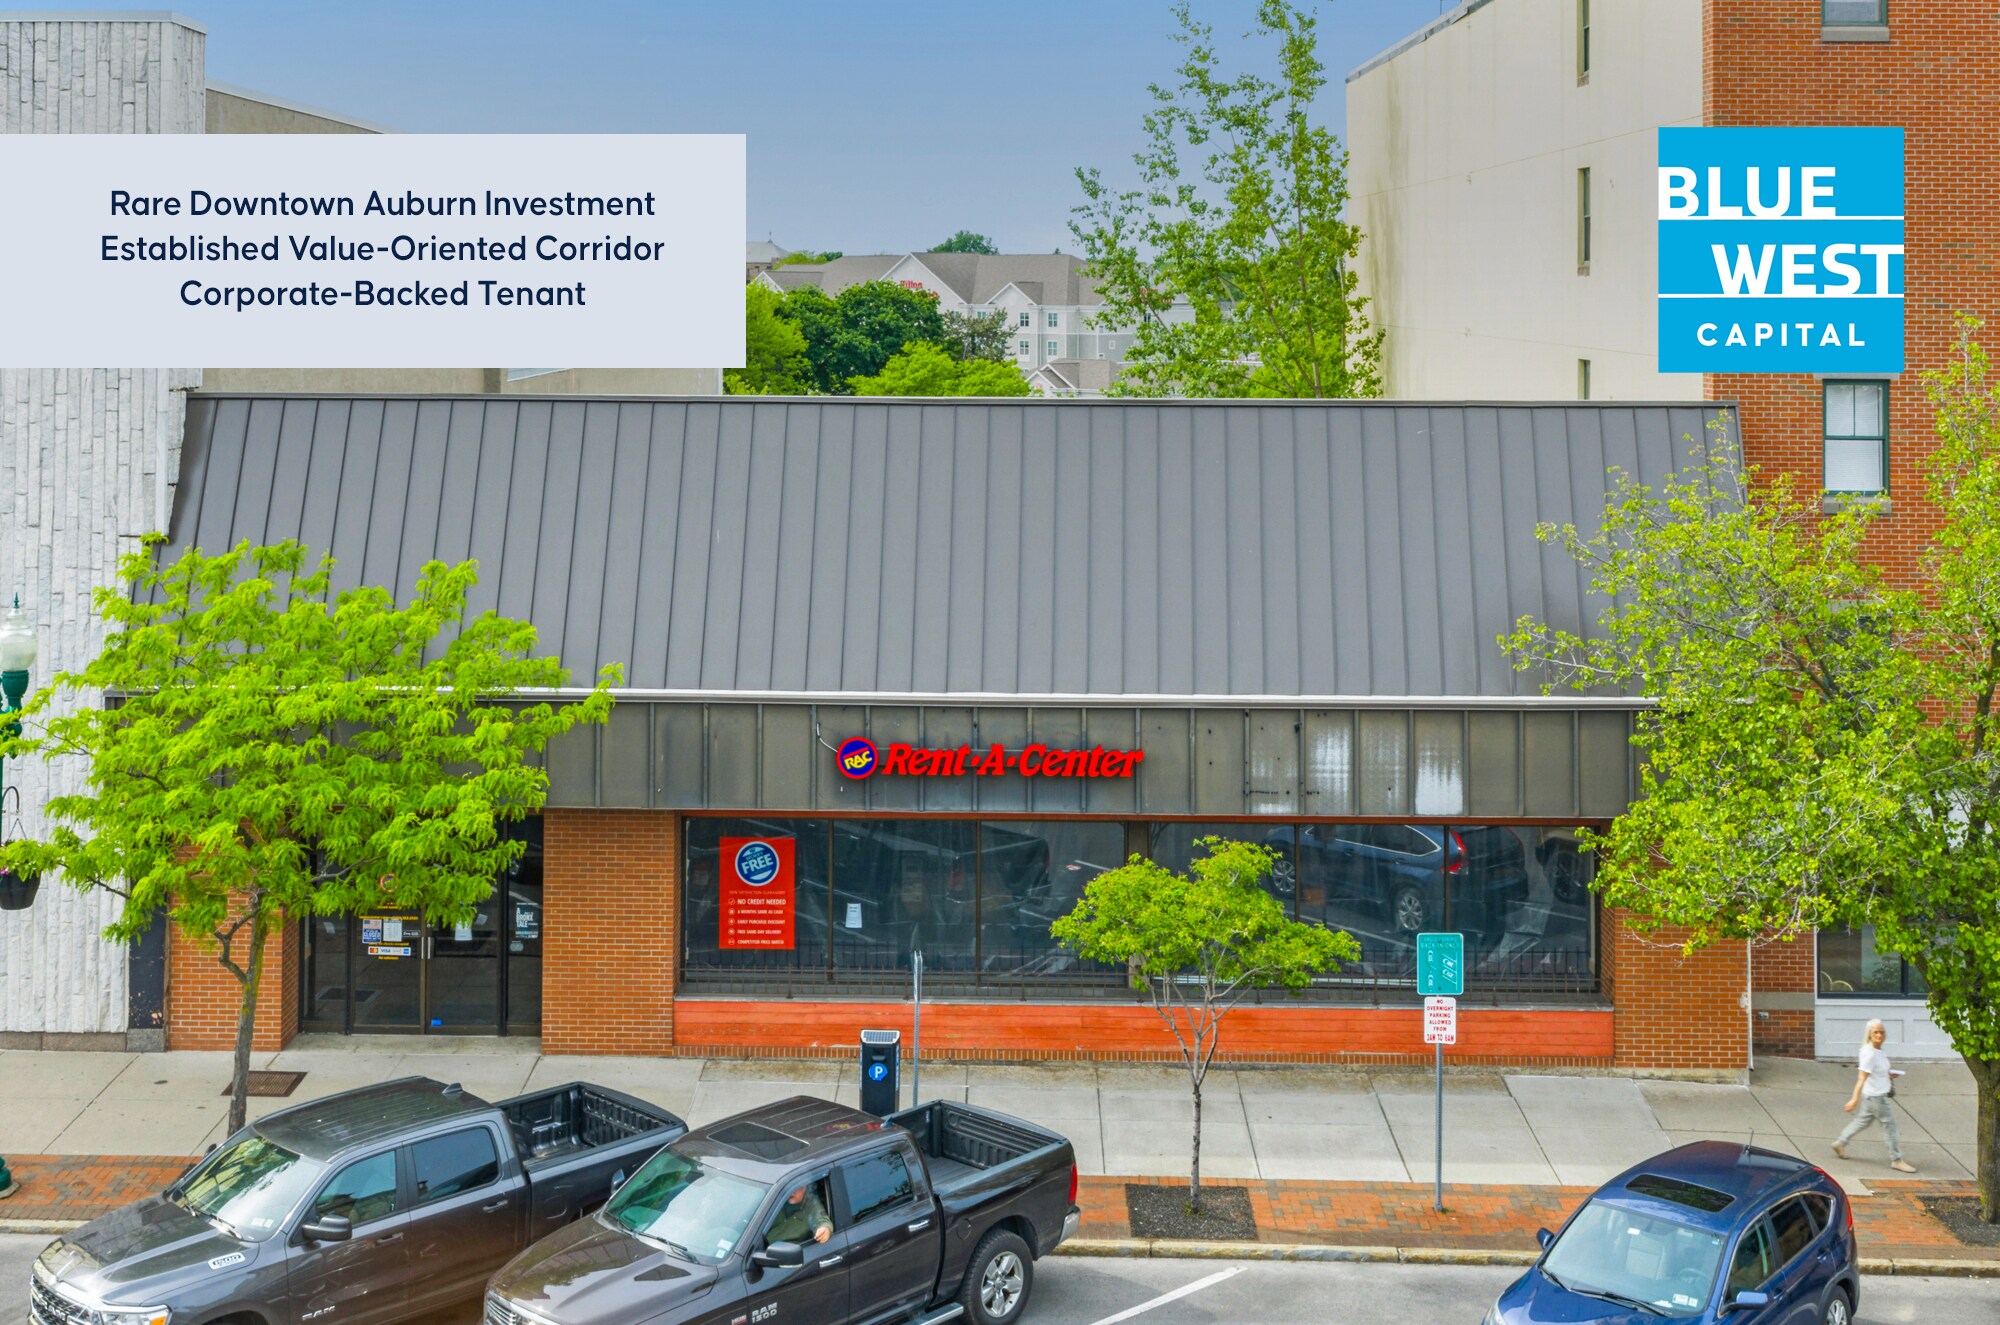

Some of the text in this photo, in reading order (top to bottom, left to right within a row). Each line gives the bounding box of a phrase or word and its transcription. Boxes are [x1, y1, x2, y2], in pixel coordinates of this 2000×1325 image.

[844, 750, 873, 770] RAC
[741, 853, 774, 875] FREE
[1437, 1033, 1444, 1042] TO
[875, 1065, 883, 1079] P
[301, 1305, 336, 1321] RAM
[751, 1301, 778, 1317] RAM
[751, 1308, 778, 1324] 1500
